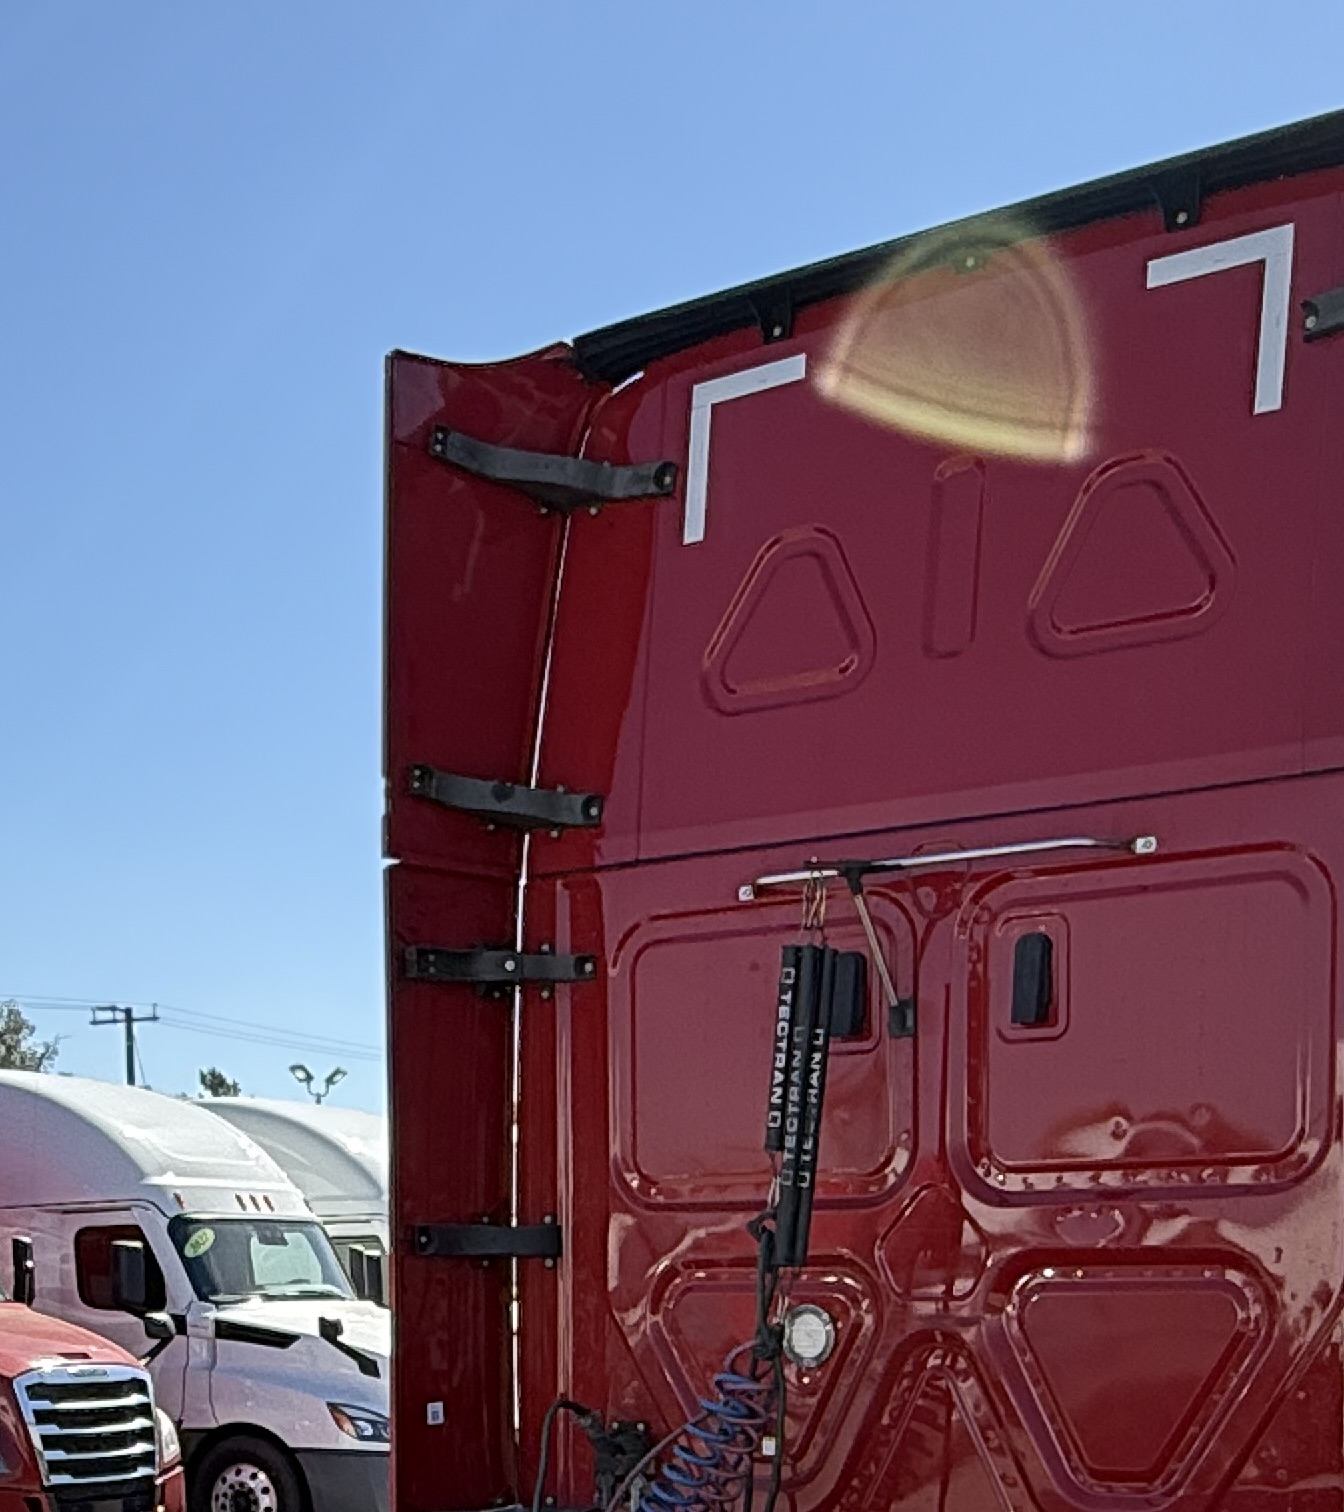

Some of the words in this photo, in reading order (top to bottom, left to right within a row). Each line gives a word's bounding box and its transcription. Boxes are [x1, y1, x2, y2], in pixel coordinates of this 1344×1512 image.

[770, 990, 792, 1105] TECTRAN
[782, 1050, 802, 1164] TECTRAN
[800, 1052, 822, 1164] TERAN
